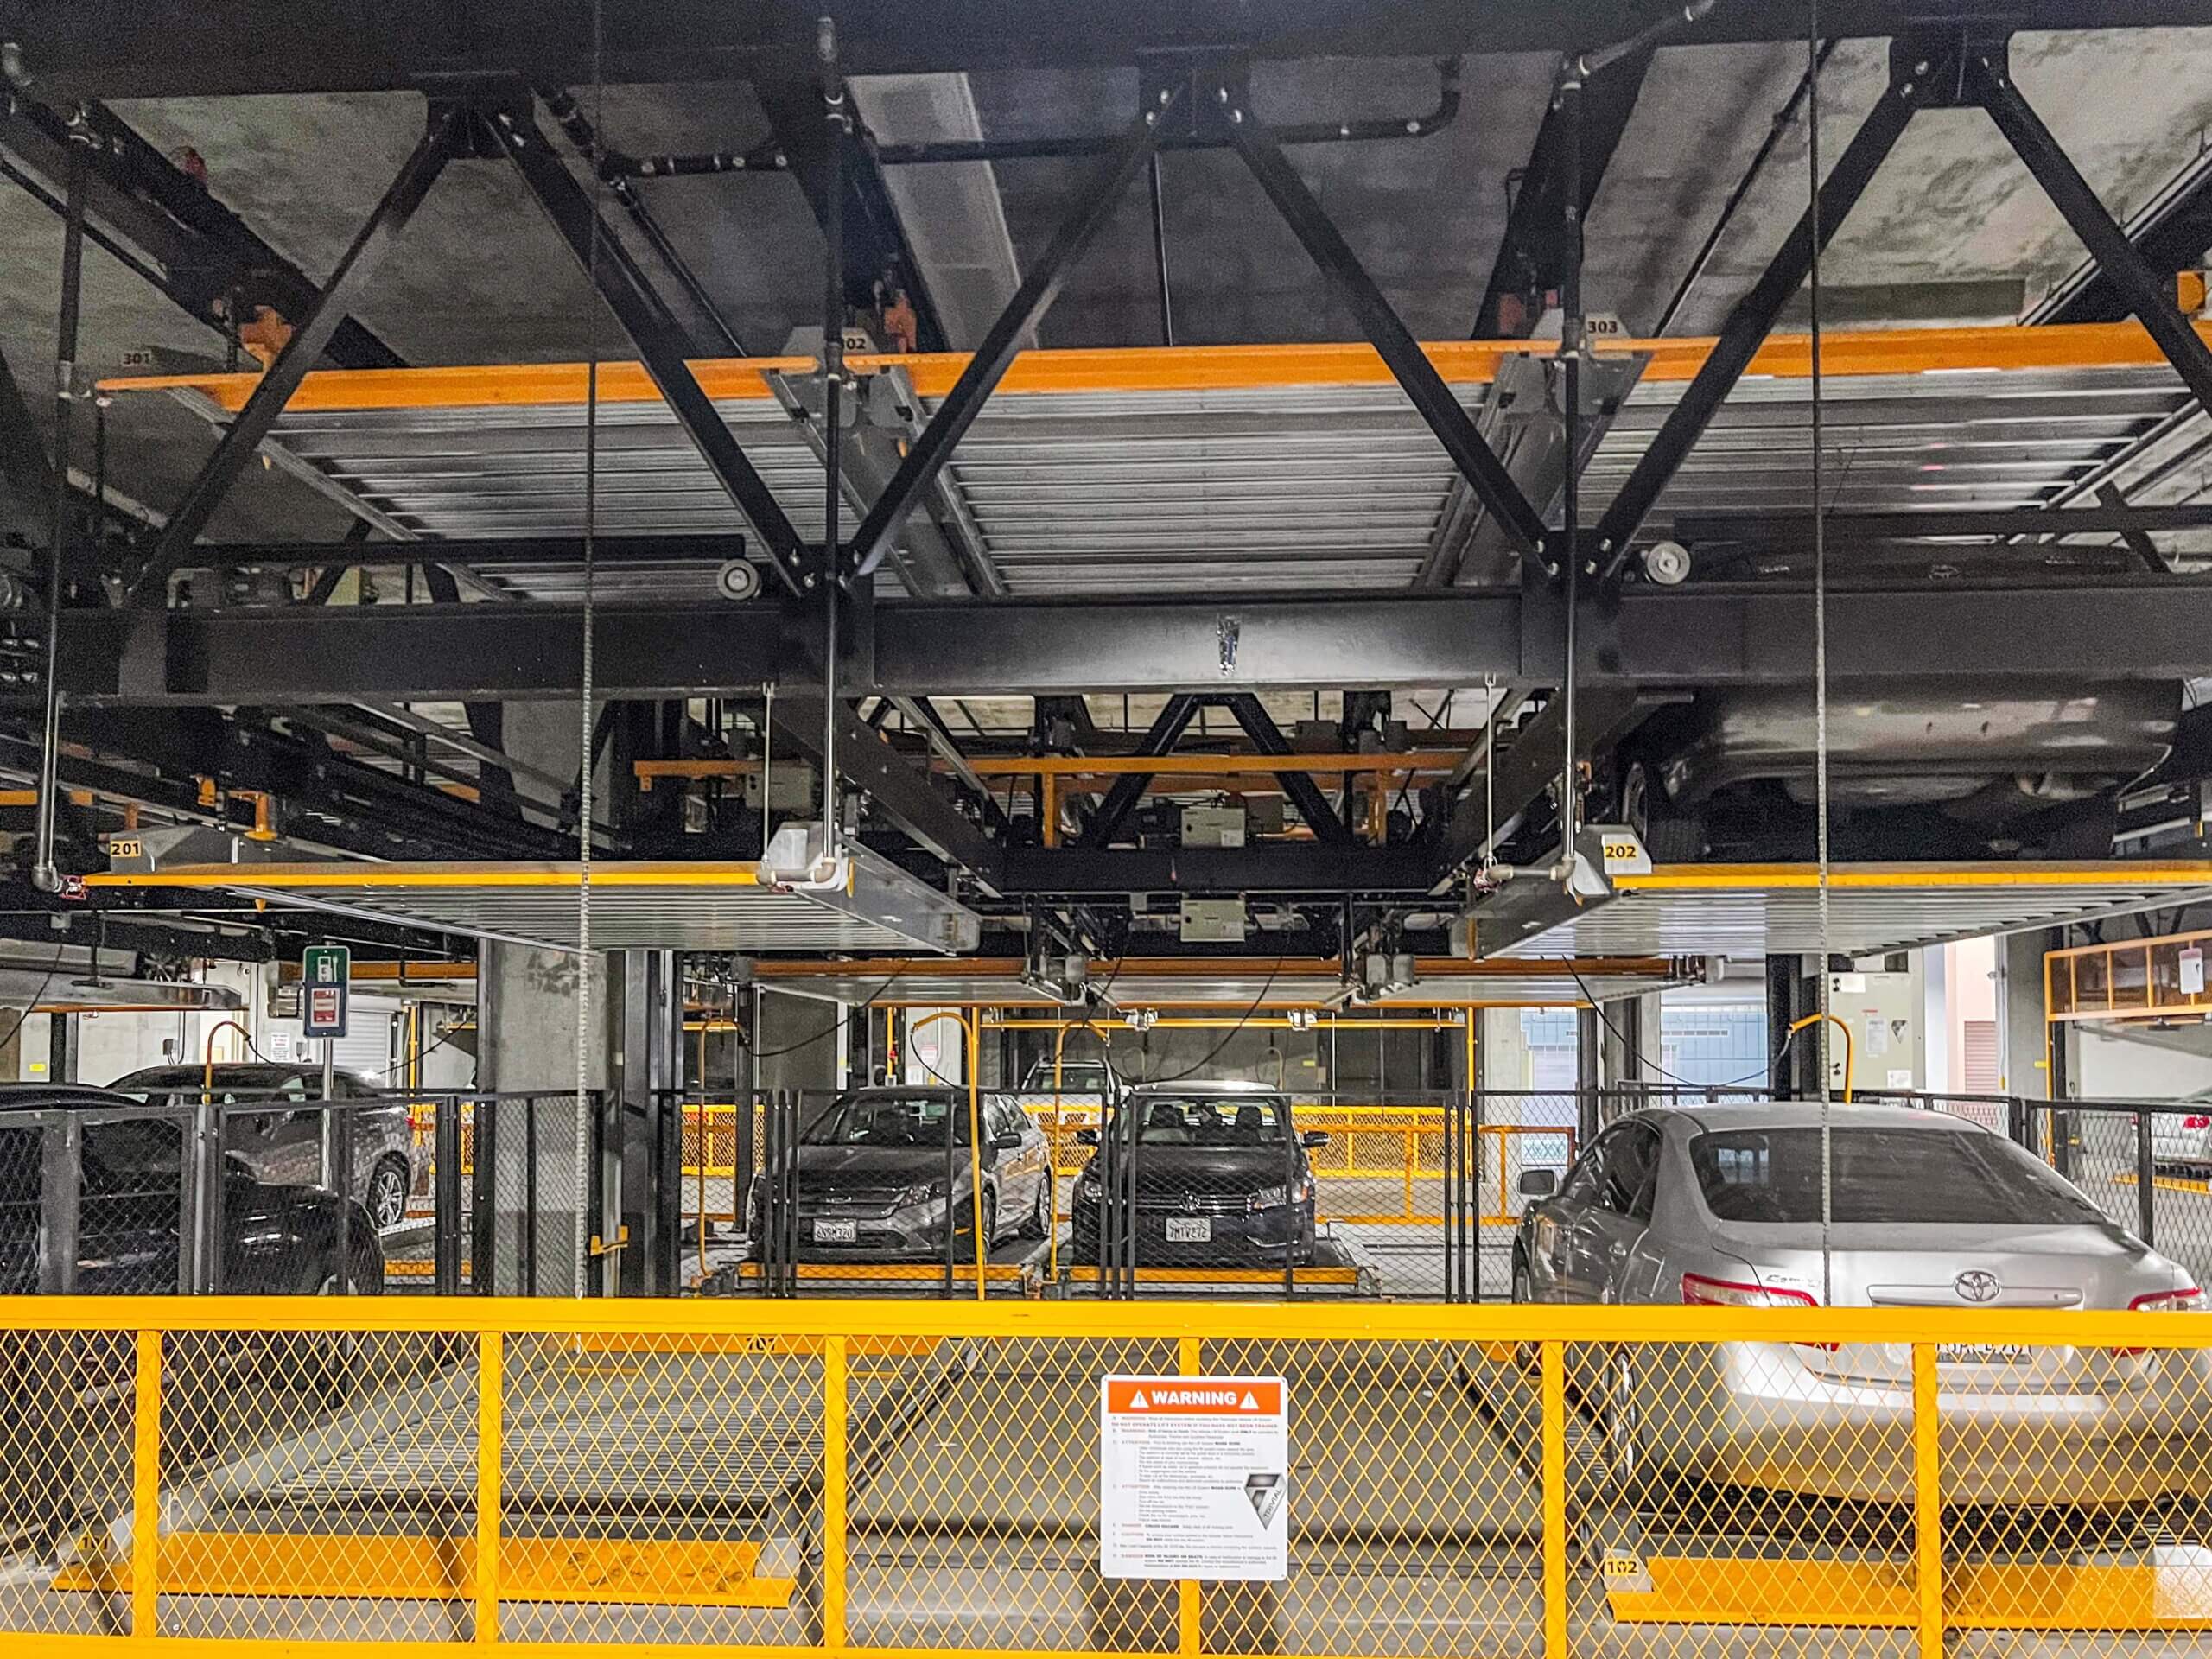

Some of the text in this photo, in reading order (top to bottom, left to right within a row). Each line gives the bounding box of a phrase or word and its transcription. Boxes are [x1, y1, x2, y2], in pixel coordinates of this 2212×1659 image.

[1588, 321, 1618, 334] 303
[842, 337, 866, 350] 02
[123, 353, 149, 364] 301
[111, 843, 139, 855] 201
[1605, 846, 1636, 858] 202
[1151, 1390, 1237, 1406] WARNING
[1607, 1560, 1638, 1573] 102
